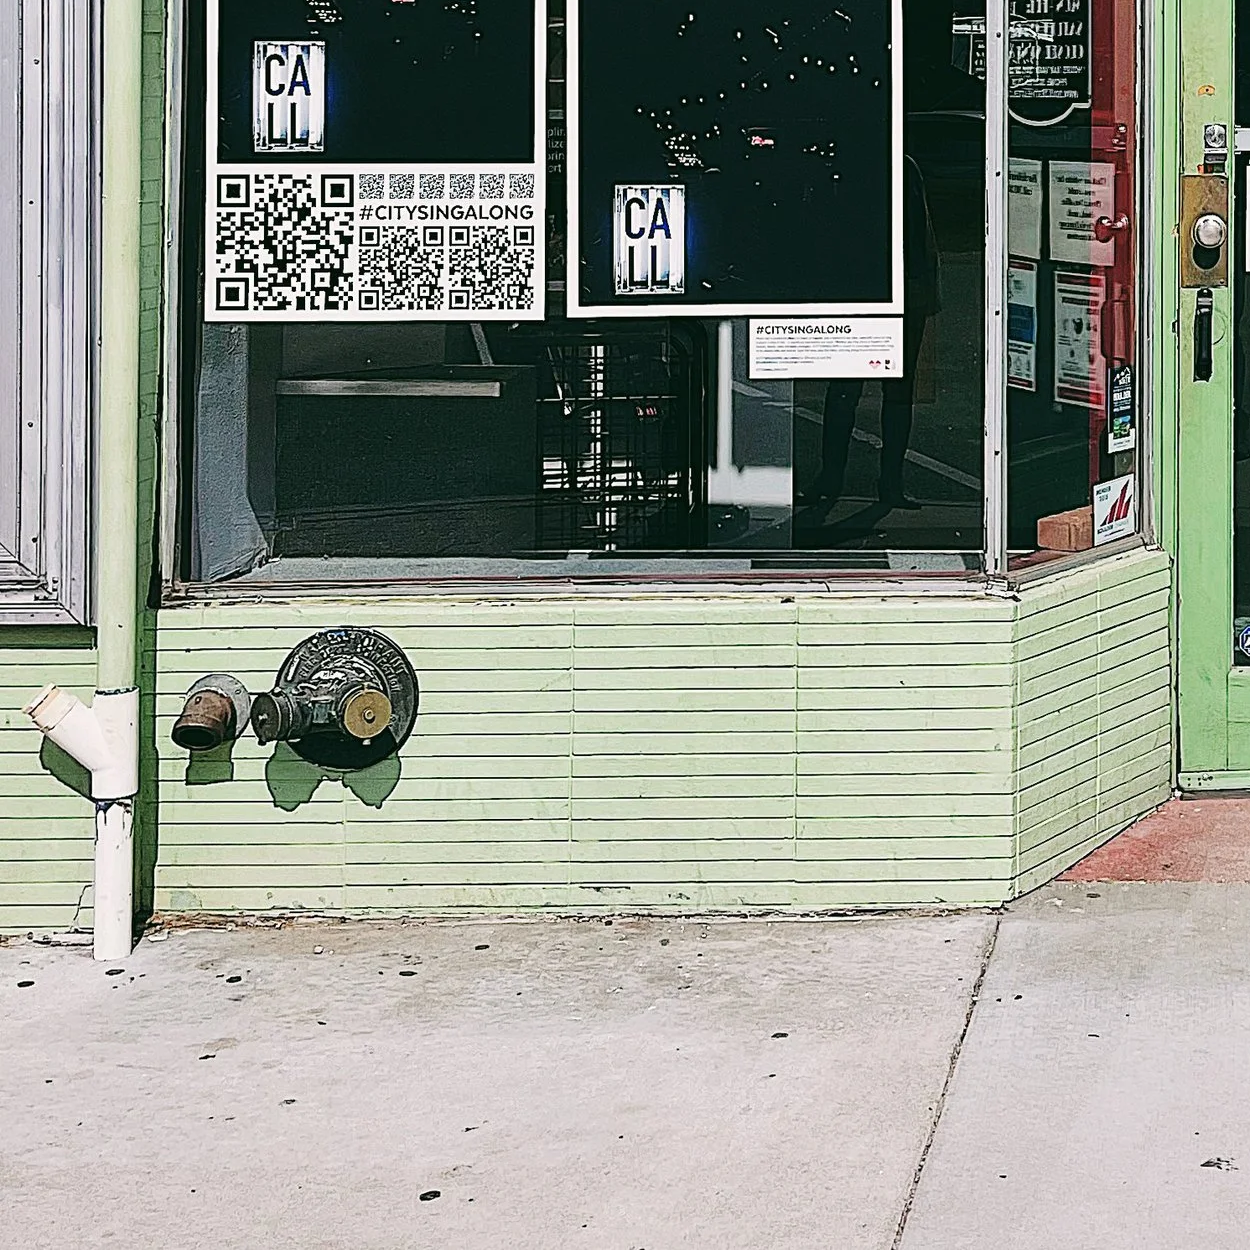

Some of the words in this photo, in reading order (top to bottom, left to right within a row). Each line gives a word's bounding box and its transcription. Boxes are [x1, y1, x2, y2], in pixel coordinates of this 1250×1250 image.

[263, 54, 311, 97] CA
[358, 204, 534, 222] #CITYSINGALONG
[623, 197, 672, 240] CA
[756, 325, 851, 335] #CITYSINGALONG
